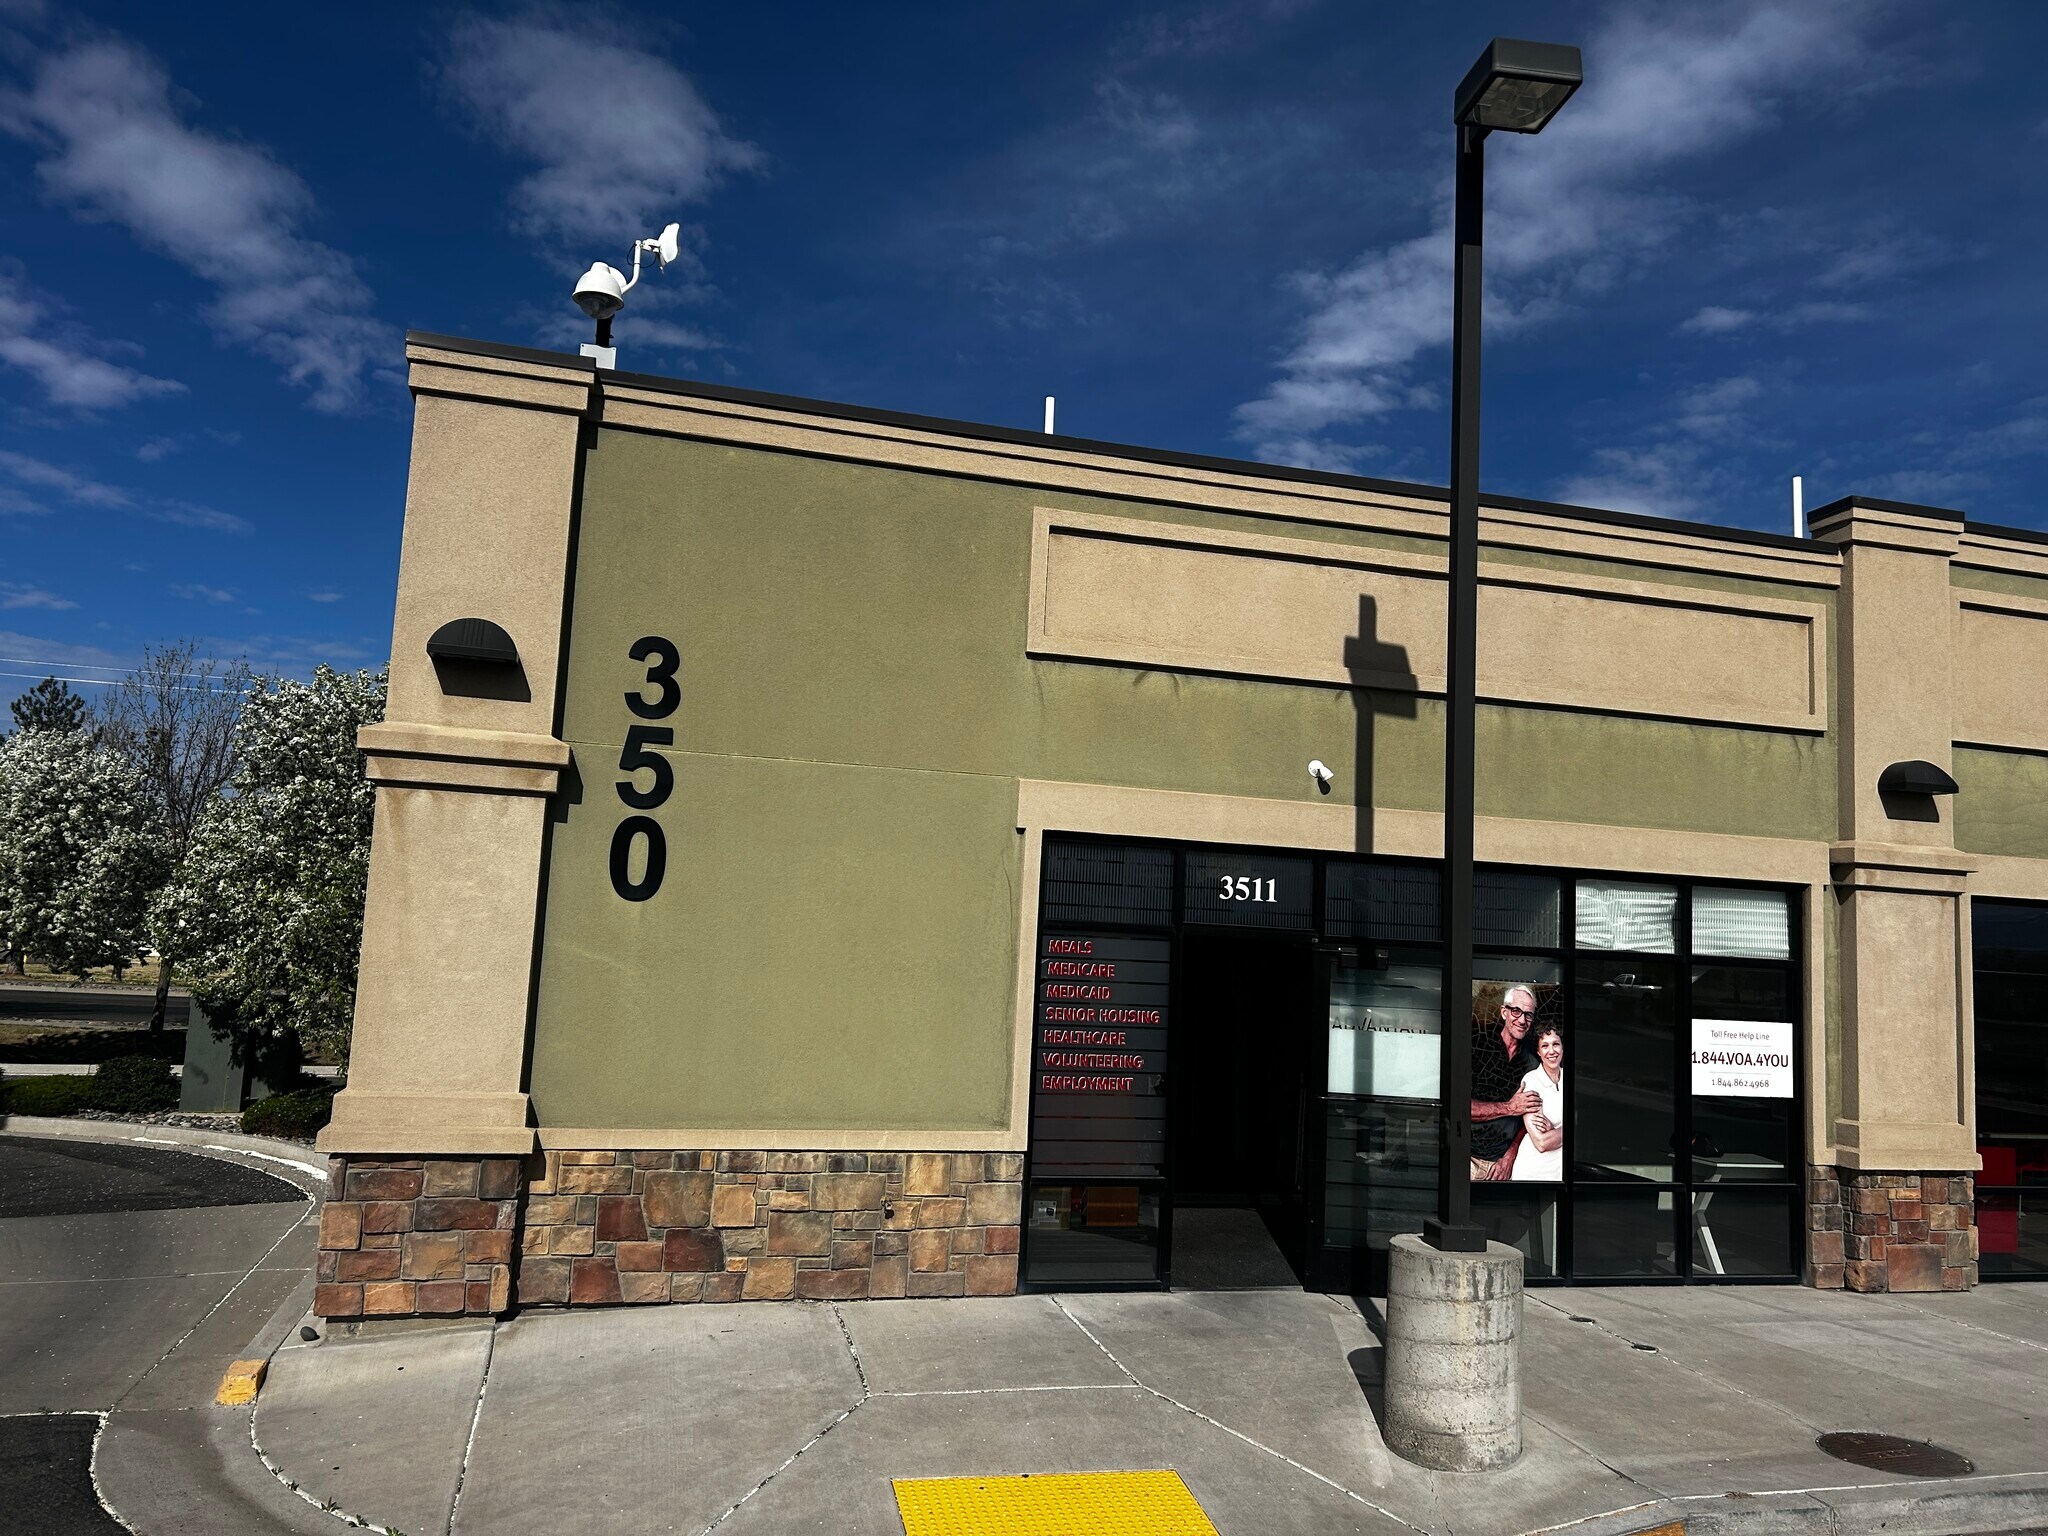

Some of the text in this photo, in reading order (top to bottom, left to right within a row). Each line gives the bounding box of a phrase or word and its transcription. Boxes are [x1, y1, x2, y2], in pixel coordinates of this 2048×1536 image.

[609, 636, 681, 902] 350
[1219, 875, 1278, 903] 3511
[1048, 939, 1093, 954] MEALS
[1047, 962, 1115, 978] MEDICARE
[1046, 985, 1111, 1000] MEDICAID
[1045, 1007, 1160, 1024] SENIOR HOUSING
[1043, 1030, 1126, 1046] HEALTHCARE
[1711, 1030, 1770, 1041] Toll Free Help Line
[1042, 1053, 1145, 1069] VOLUNTEERING
[1691, 1051, 1789, 1068] 1.844.VOA.4YOU
[1042, 1075, 1134, 1091] EMPLOYMENT
